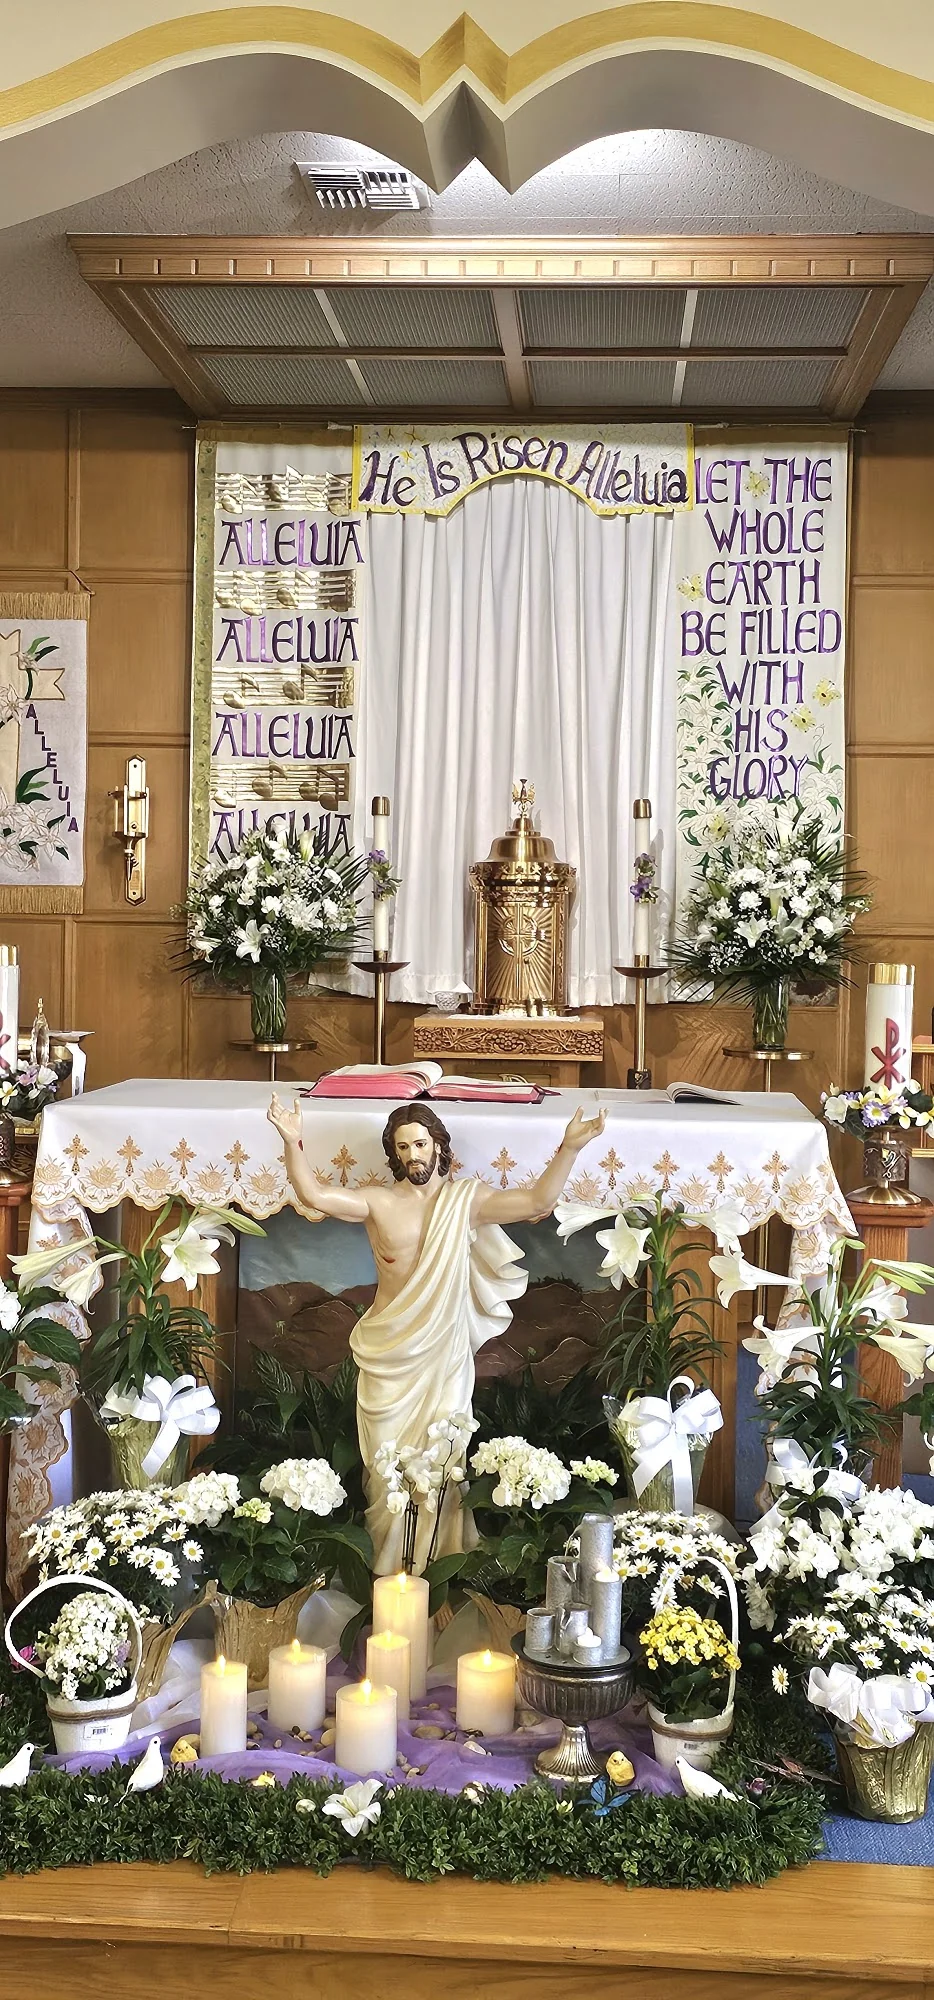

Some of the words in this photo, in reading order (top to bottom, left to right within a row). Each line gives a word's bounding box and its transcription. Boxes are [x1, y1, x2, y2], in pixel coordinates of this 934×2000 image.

[358, 450, 417, 506] He
[422, 443, 460, 500] Is
[452, 431, 571, 484] Risen
[567, 440, 690, 507] Alleluia
[694, 457, 750, 505] LET
[764, 457, 833, 505] THE
[218, 519, 365, 567] ALLELUIA
[704, 506, 824, 555] WHOLE
[705, 558, 821, 606] EARTH
[216, 616, 360, 664] ALLELUIA
[680, 608, 726, 656] BE
[740, 607, 842, 656] FILLED
[716, 658, 805, 706] WITH
[212, 710, 356, 759] ALLELUIA
[734, 708, 789, 753] HIS
[26, 703, 78, 832] ALLELUIA
[709, 752, 809, 801] GLORY
